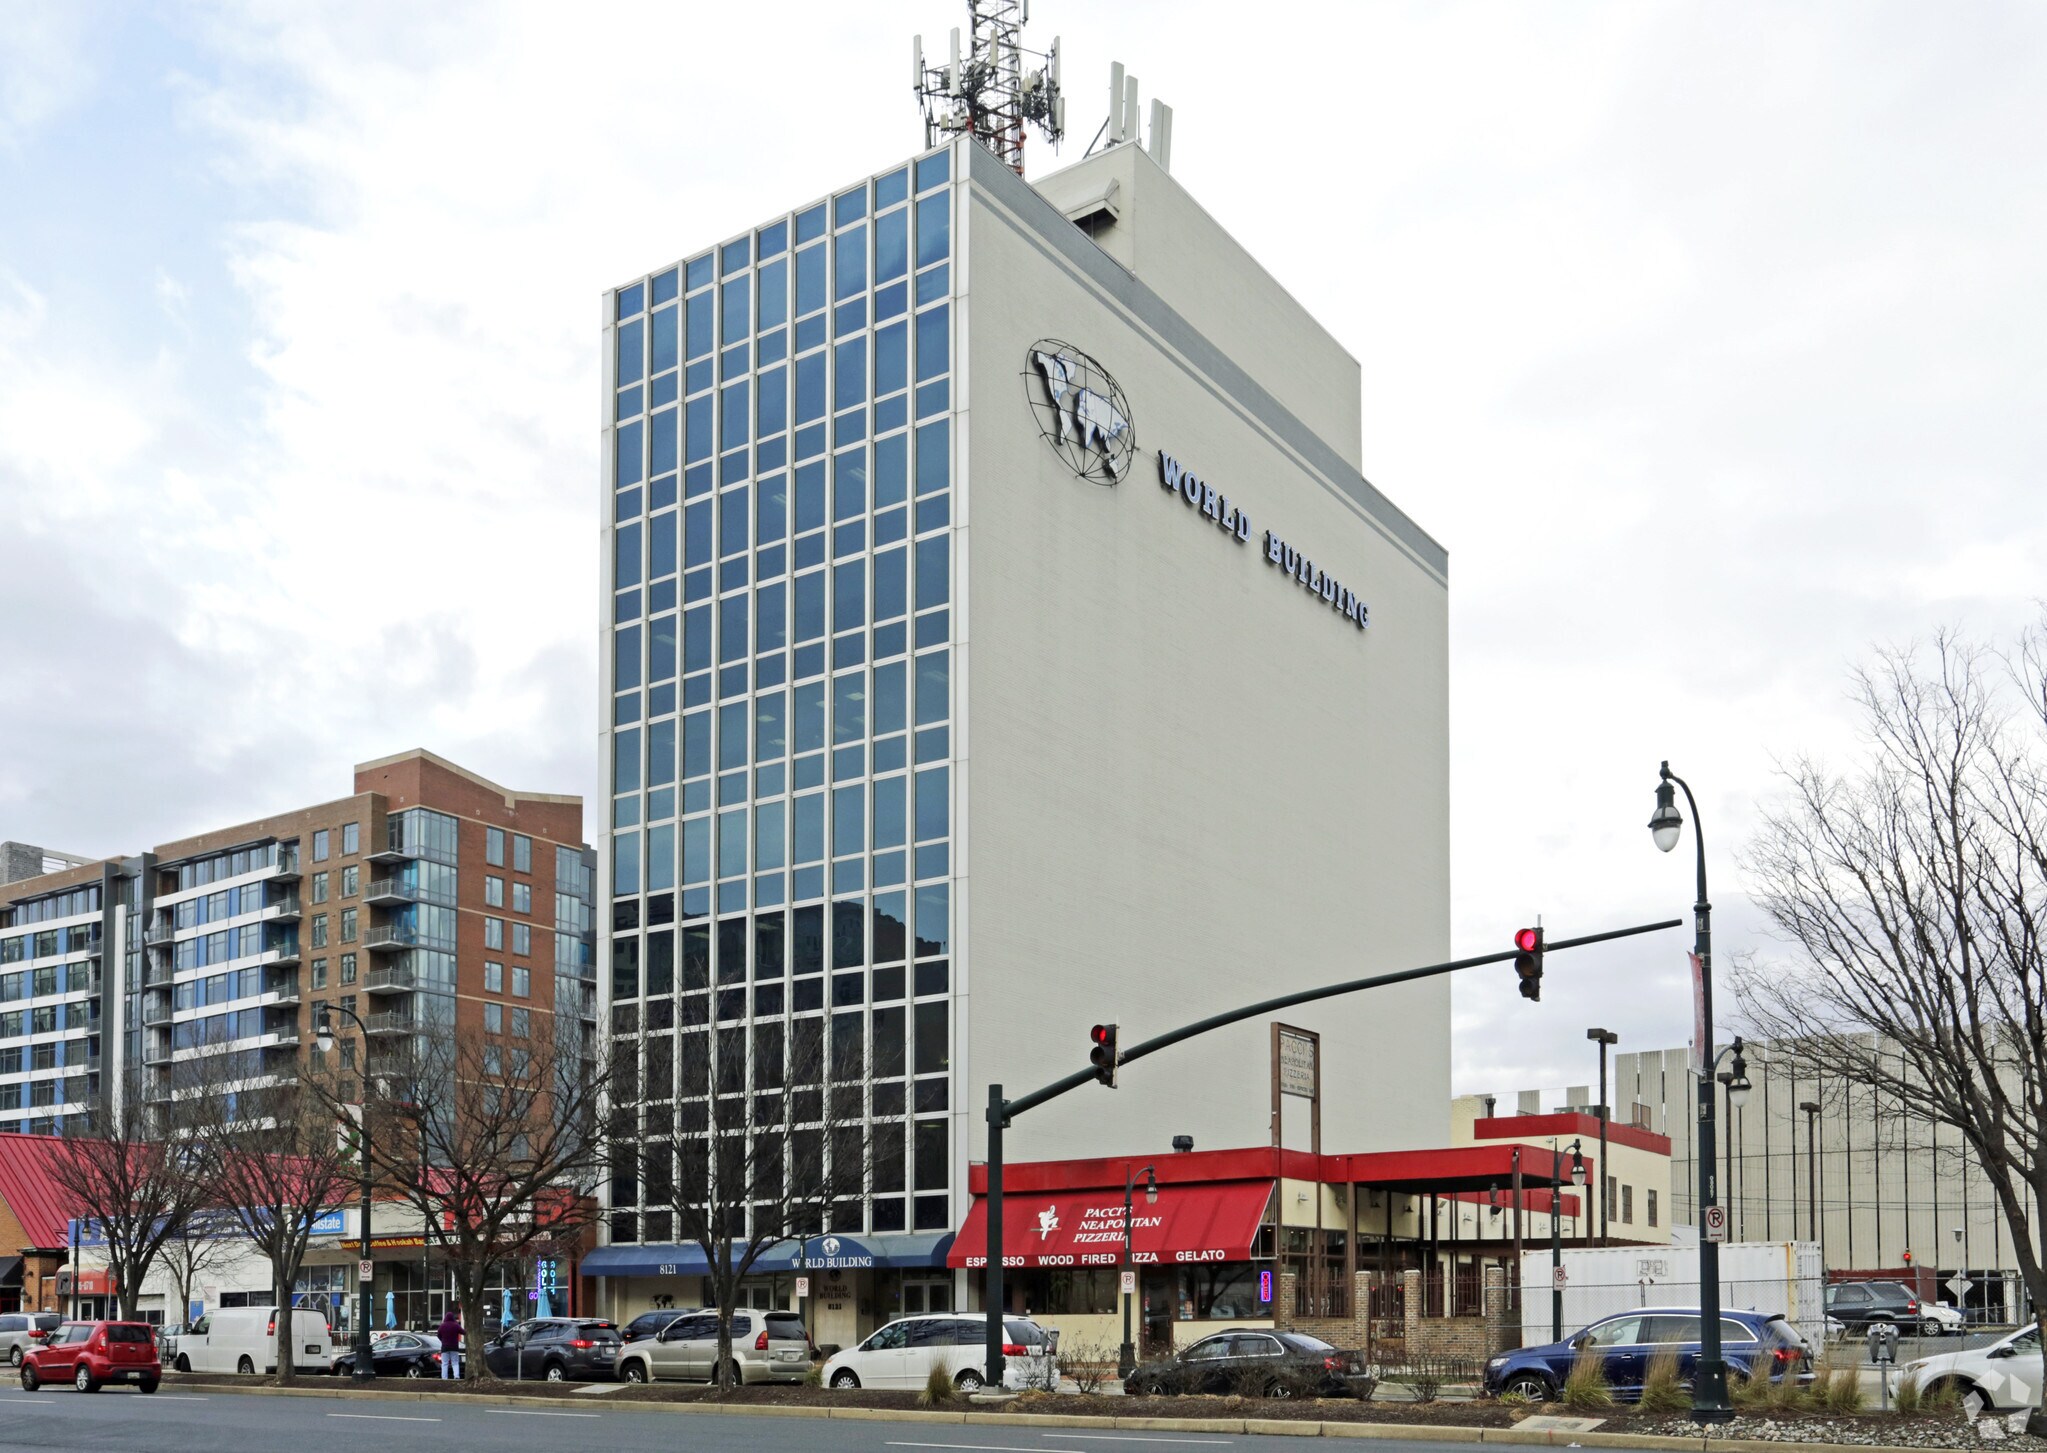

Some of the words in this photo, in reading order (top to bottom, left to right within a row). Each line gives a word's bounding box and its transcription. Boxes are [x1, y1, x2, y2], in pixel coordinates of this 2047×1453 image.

[1158, 449, 1251, 543] WORLD
[1264, 529, 1370, 629] BUILDING
[1073, 1231, 1126, 1243] PIZZERI
[792, 1258, 825, 1268] WRLD
[827, 1256, 872, 1268] BUILDING
[966, 1256, 1025, 1267] ESPSSO
[1038, 1255, 1074, 1266] WOOD
[1081, 1253, 1116, 1265] FIRED
[1132, 1252, 1159, 1263] IZZA
[1175, 1249, 1225, 1261] GELATO
[659, 1264, 677, 1275] 8121
[820, 1291, 851, 1299] BUILDING
